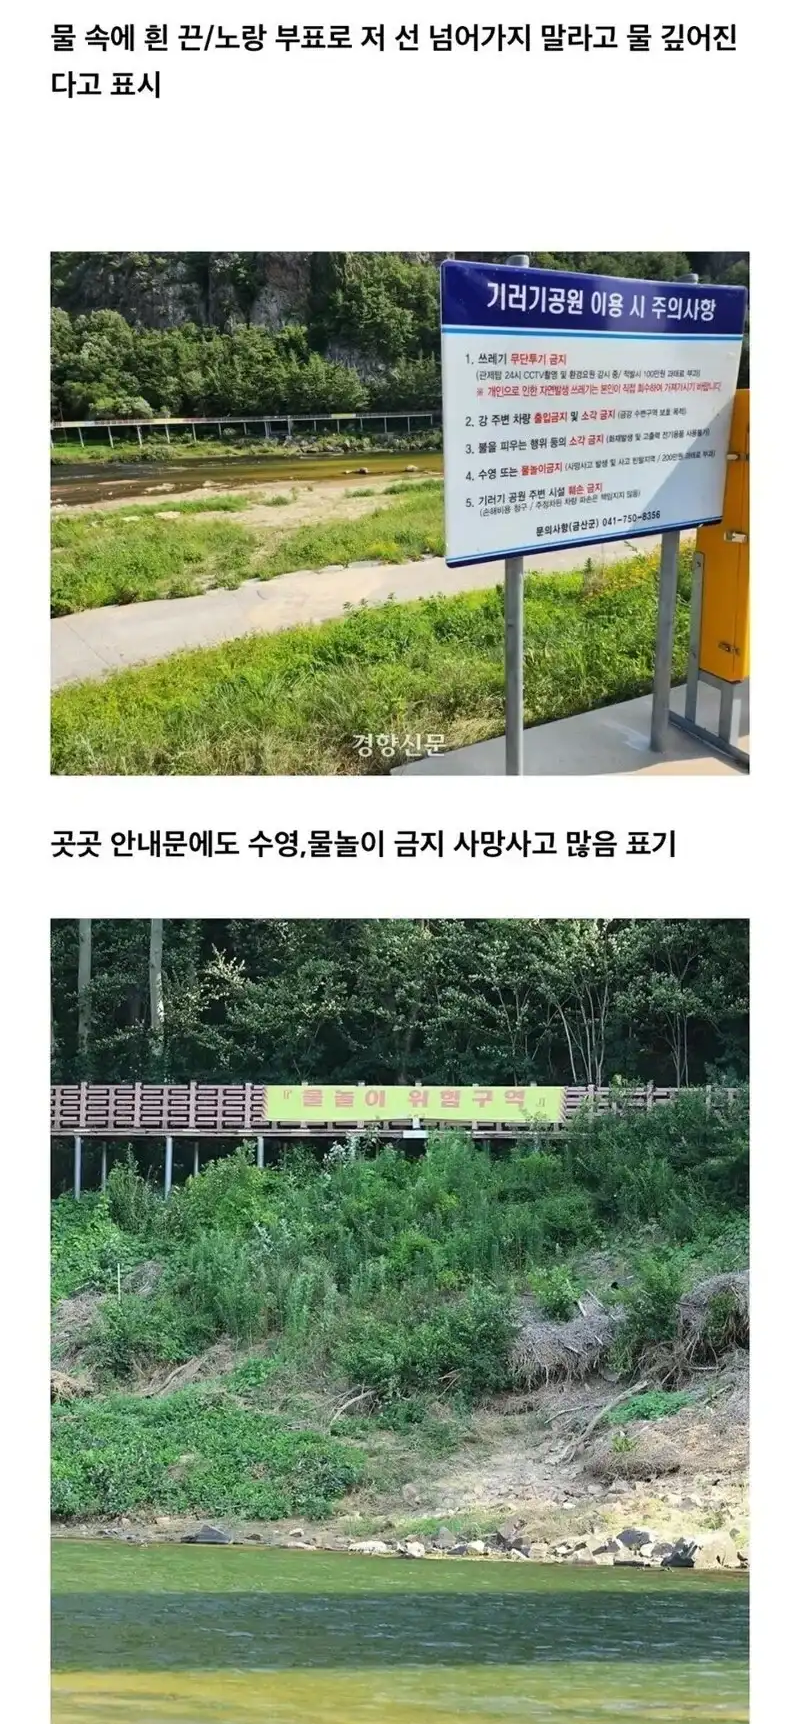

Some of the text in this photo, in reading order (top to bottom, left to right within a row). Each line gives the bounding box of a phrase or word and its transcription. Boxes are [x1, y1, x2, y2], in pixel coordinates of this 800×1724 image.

[487, 282, 716, 321] 기러기공원 이용 시 주의사항
[478, 354, 507, 365] 쓰레기
[510, 354, 546, 366] 무단투기
[549, 354, 567, 365] 금지
[504, 370, 521, 380] 24시
[465, 409, 615, 427] 2. 강 주변 차량 출입금지 및 소각 금지
[478, 441, 497, 454] 불을
[500, 439, 527, 452] 피우는
[530, 438, 547, 450] 행위
[550, 436, 566, 448] 등의
[569, 435, 586, 446] 소각
[587, 433, 604, 445] 금지
[478, 468, 496, 480] 수영
[500, 466, 518, 478] 또는
[521, 462, 563, 476] 물놀이금지
[479, 494, 505, 506] 기러기
[509, 491, 526, 503] 공원
[530, 489, 546, 500] 주변
[549, 486, 566, 498] 시설
[587, 482, 602, 494] 금지
[603, 510, 661, 527] 041-750-8356
